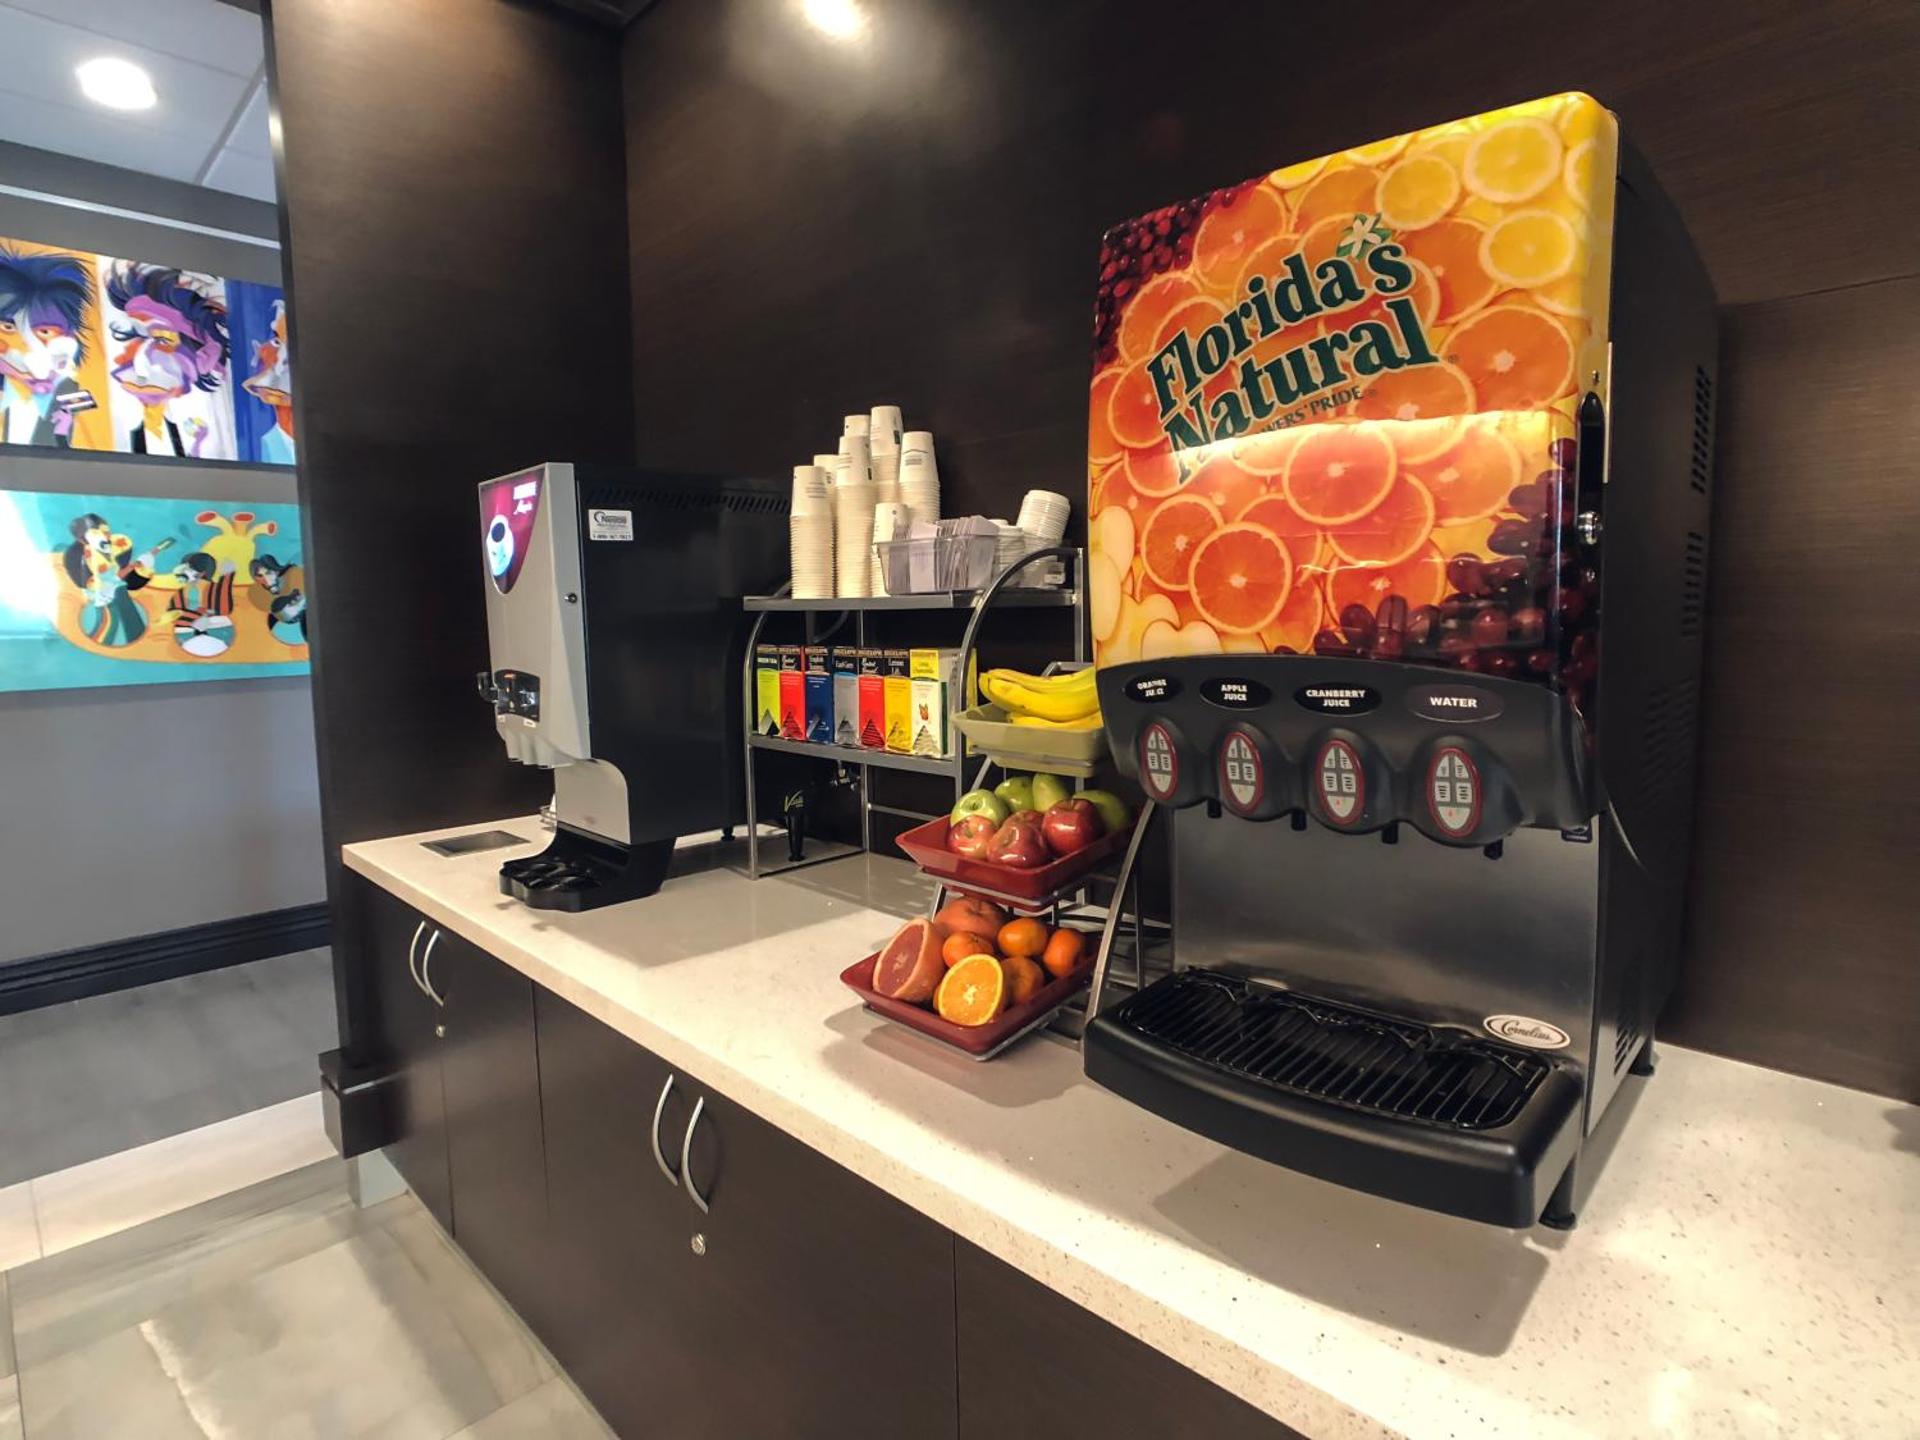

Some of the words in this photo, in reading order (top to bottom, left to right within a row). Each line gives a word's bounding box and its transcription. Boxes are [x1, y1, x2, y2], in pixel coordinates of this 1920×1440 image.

[1163, 298, 1440, 485] Natural
[1309, 385, 1364, 417] PRIDE
[1221, 683, 1248, 693] APPLE
[1223, 692, 1248, 701] JUICE
[1306, 689, 1366, 699] CRANBERRY
[1322, 698, 1351, 708] JUICE
[1429, 696, 1478, 709] WATER
